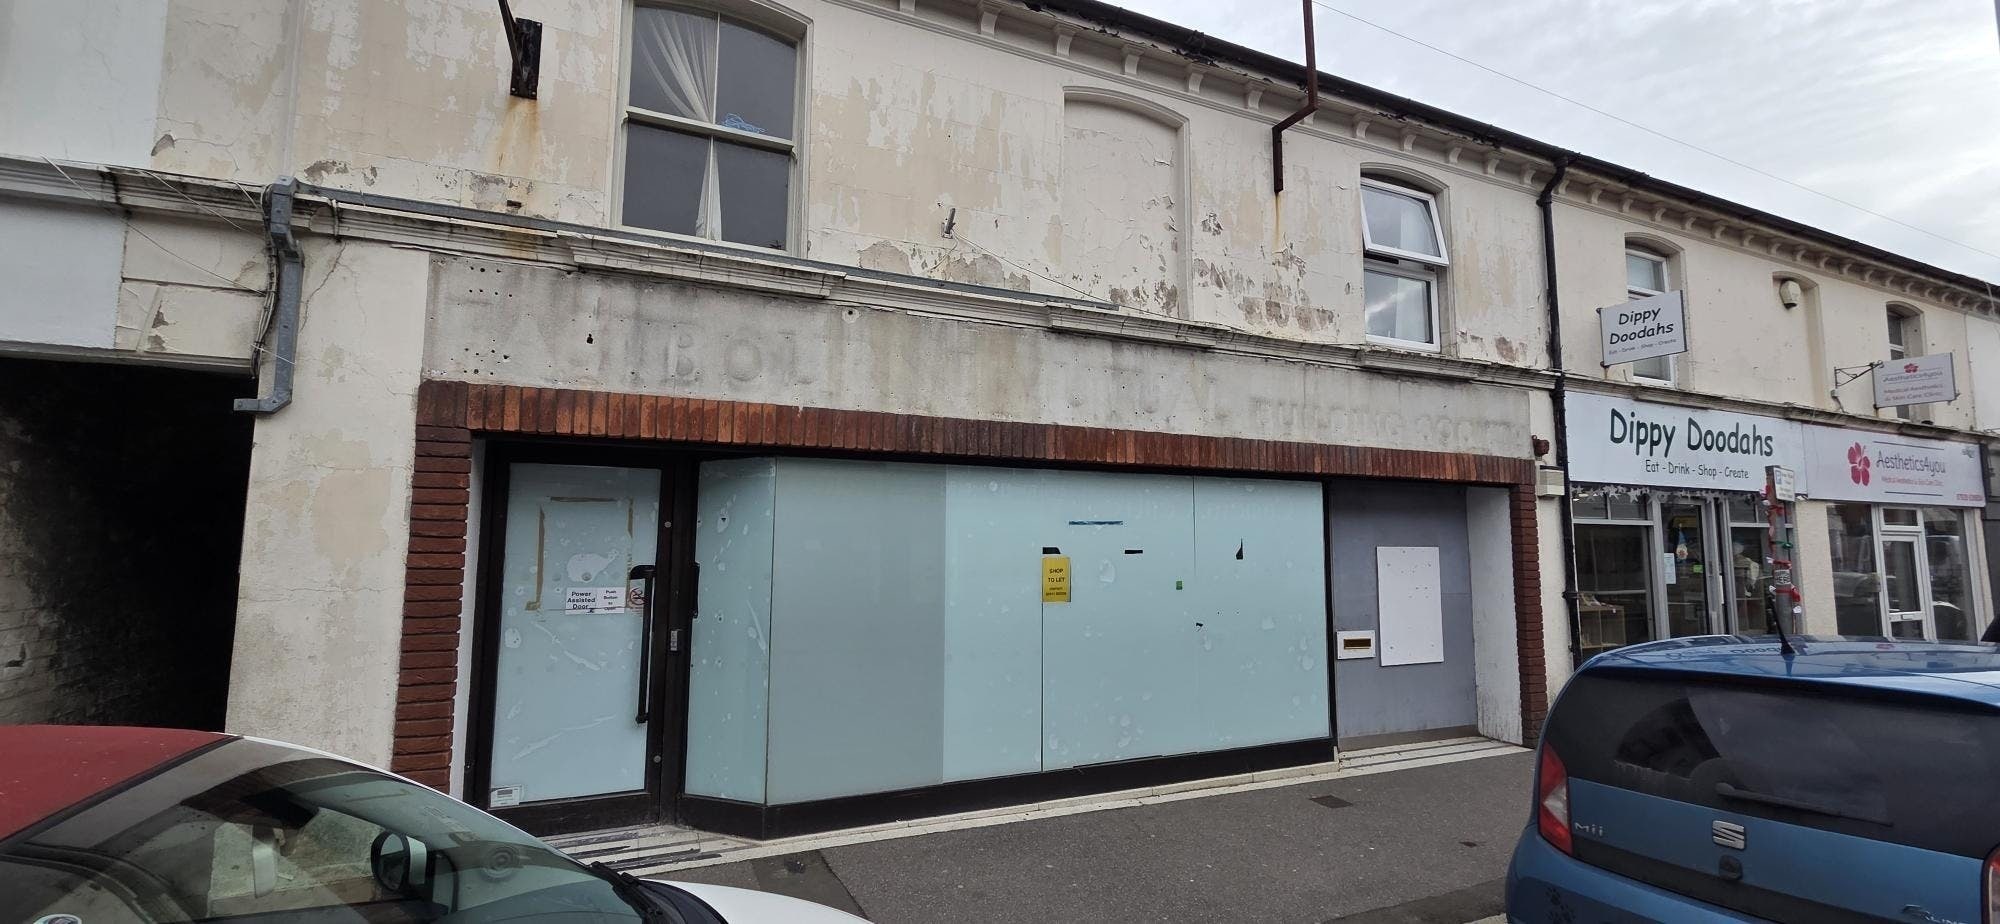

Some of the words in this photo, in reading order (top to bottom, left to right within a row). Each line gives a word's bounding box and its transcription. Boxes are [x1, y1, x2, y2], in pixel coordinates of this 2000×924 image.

[1618, 307, 1661, 325] Dippy
[1609, 322, 1674, 345] Doodahs
[1610, 407, 1676, 458] Dippy
[1687, 416, 1774, 457] Doodahs
[1645, 459, 1660, 473] Eat
[1668, 461, 1690, 475] Drink
[1698, 464, 1717, 479] Shop
[1724, 466, 1749, 479] Create
[1876, 450, 1946, 477] Aesthetics4you
[1574, 821, 1603, 837] Mii
